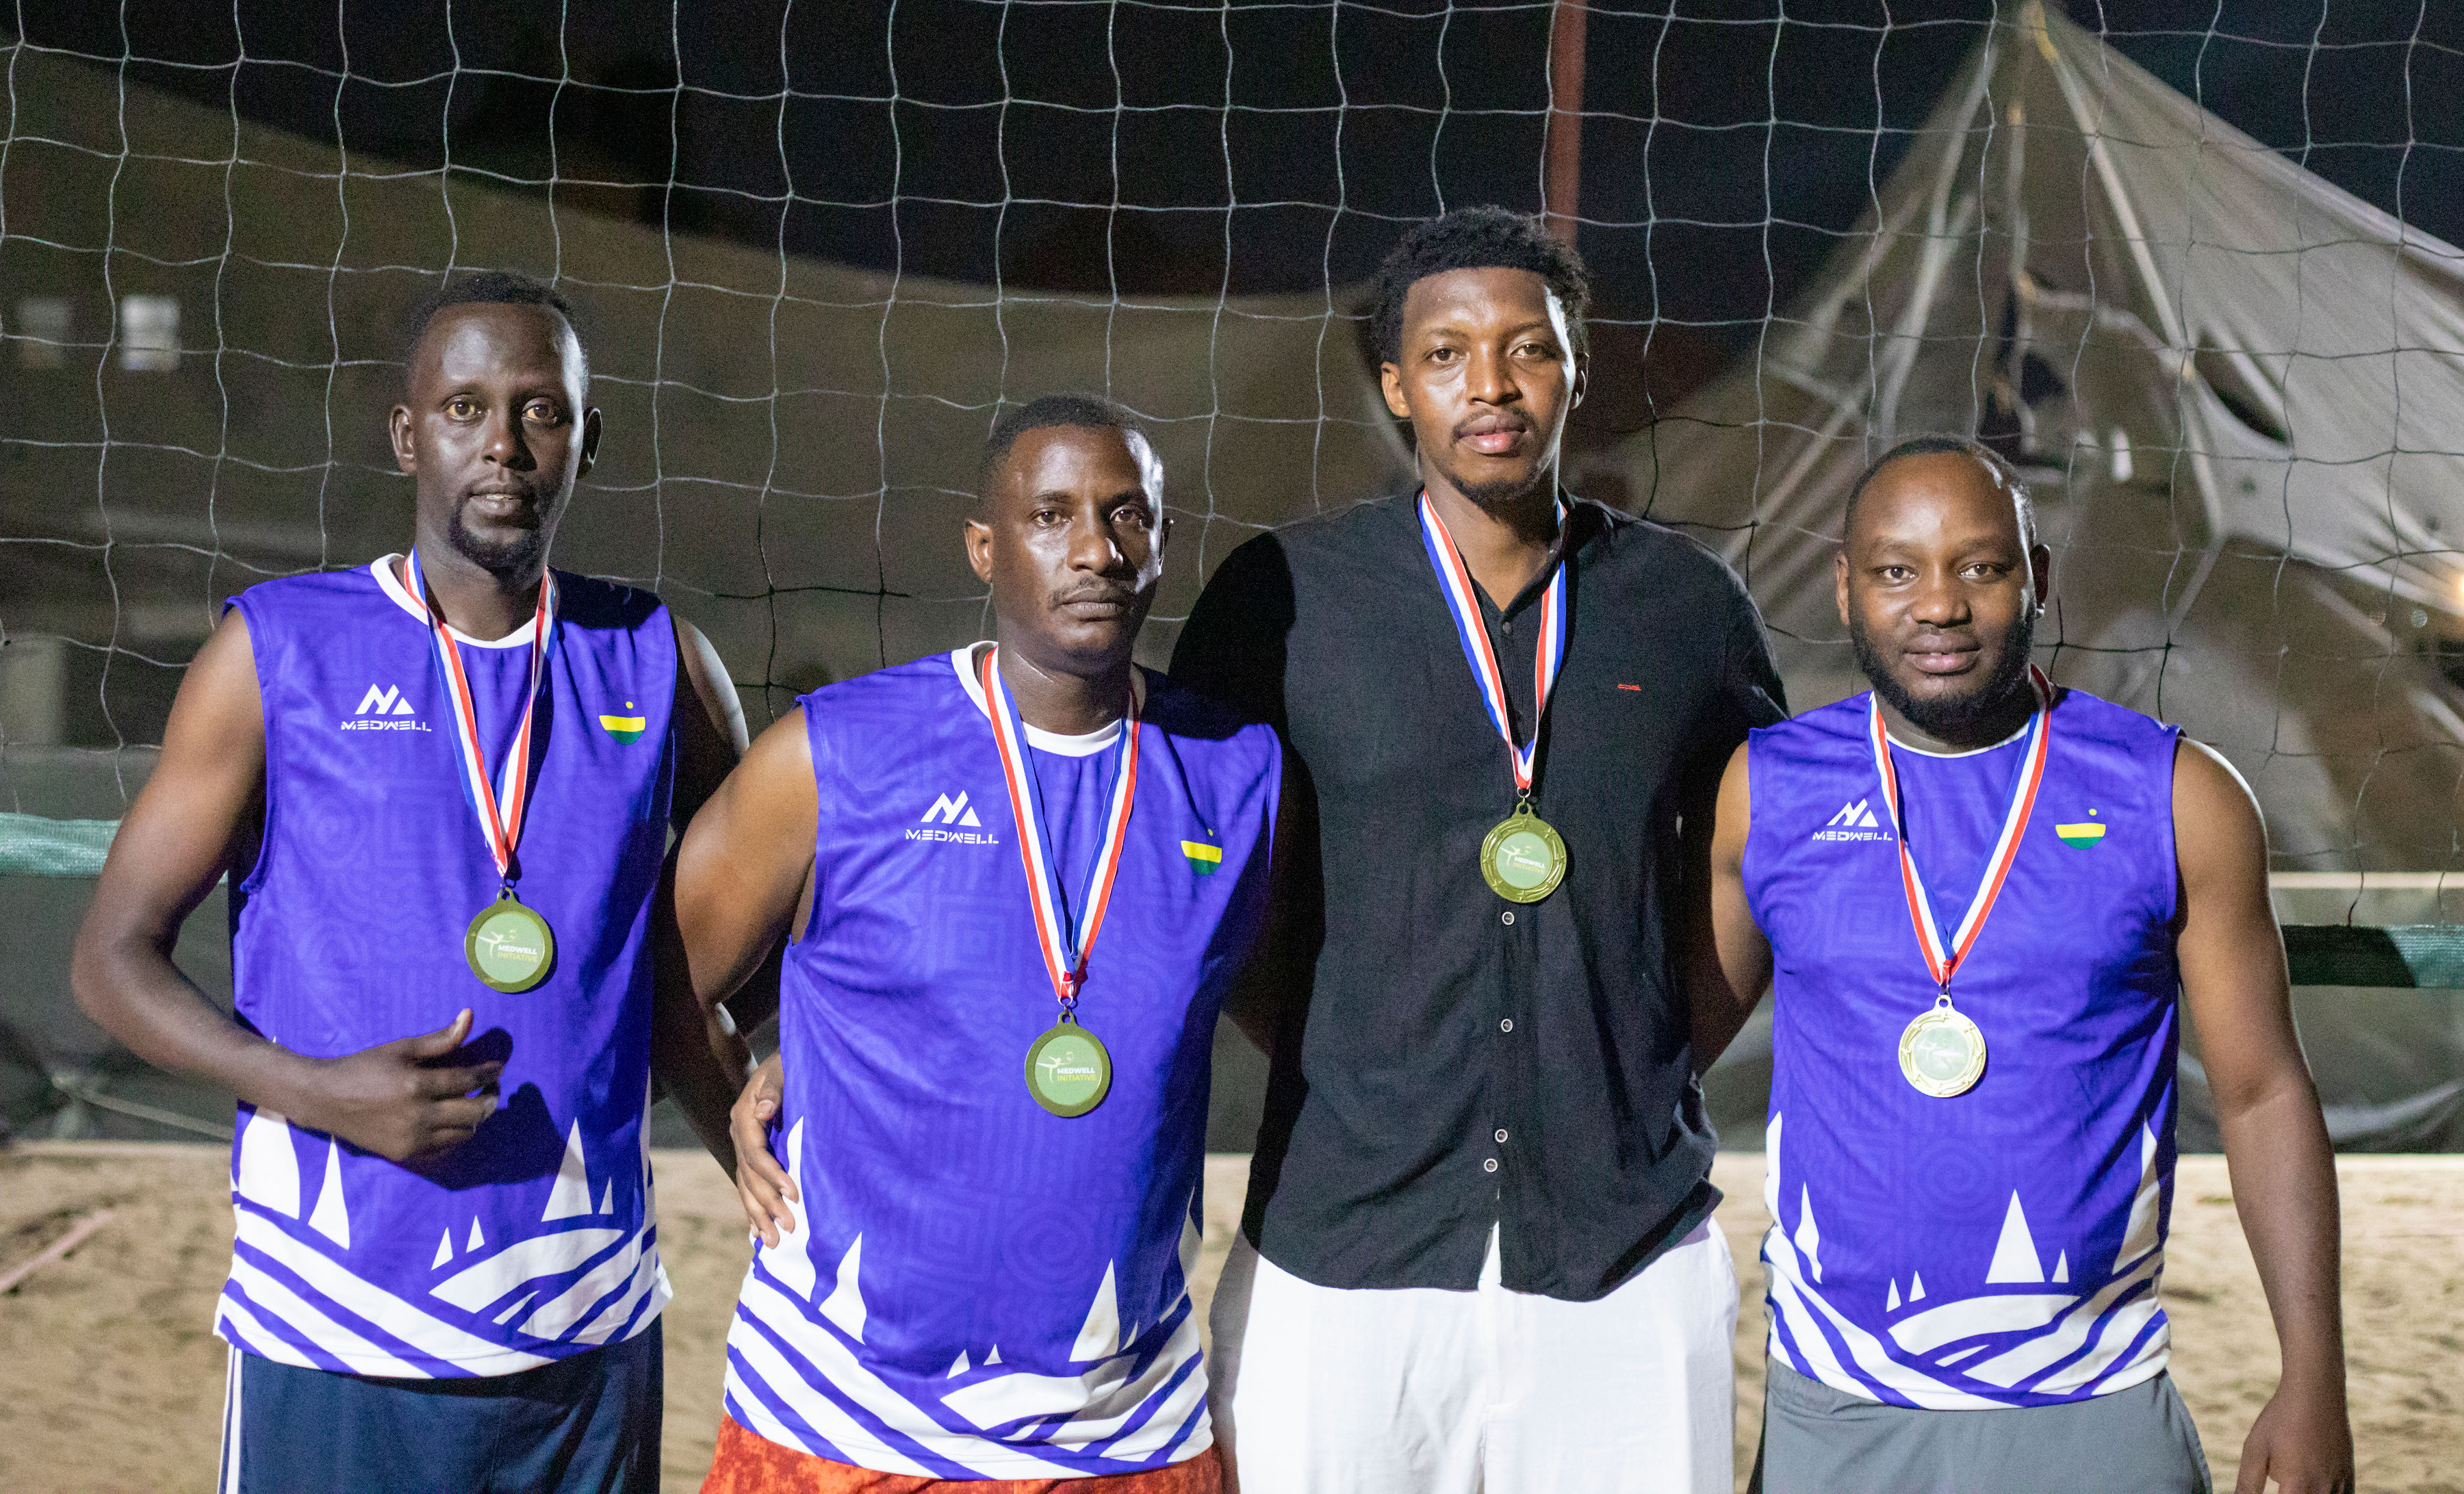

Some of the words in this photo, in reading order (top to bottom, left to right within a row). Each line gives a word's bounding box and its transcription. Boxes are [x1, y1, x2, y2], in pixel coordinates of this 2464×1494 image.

[341, 720, 432, 732] MEDWELL
[906, 829, 999, 845] MEDWELL
[1812, 831, 1893, 841] MEDWELL
[1514, 856, 1545, 868] MEDWELL
[498, 944, 537, 955] MEDWELL
[498, 952, 537, 962] INITIATIVE
